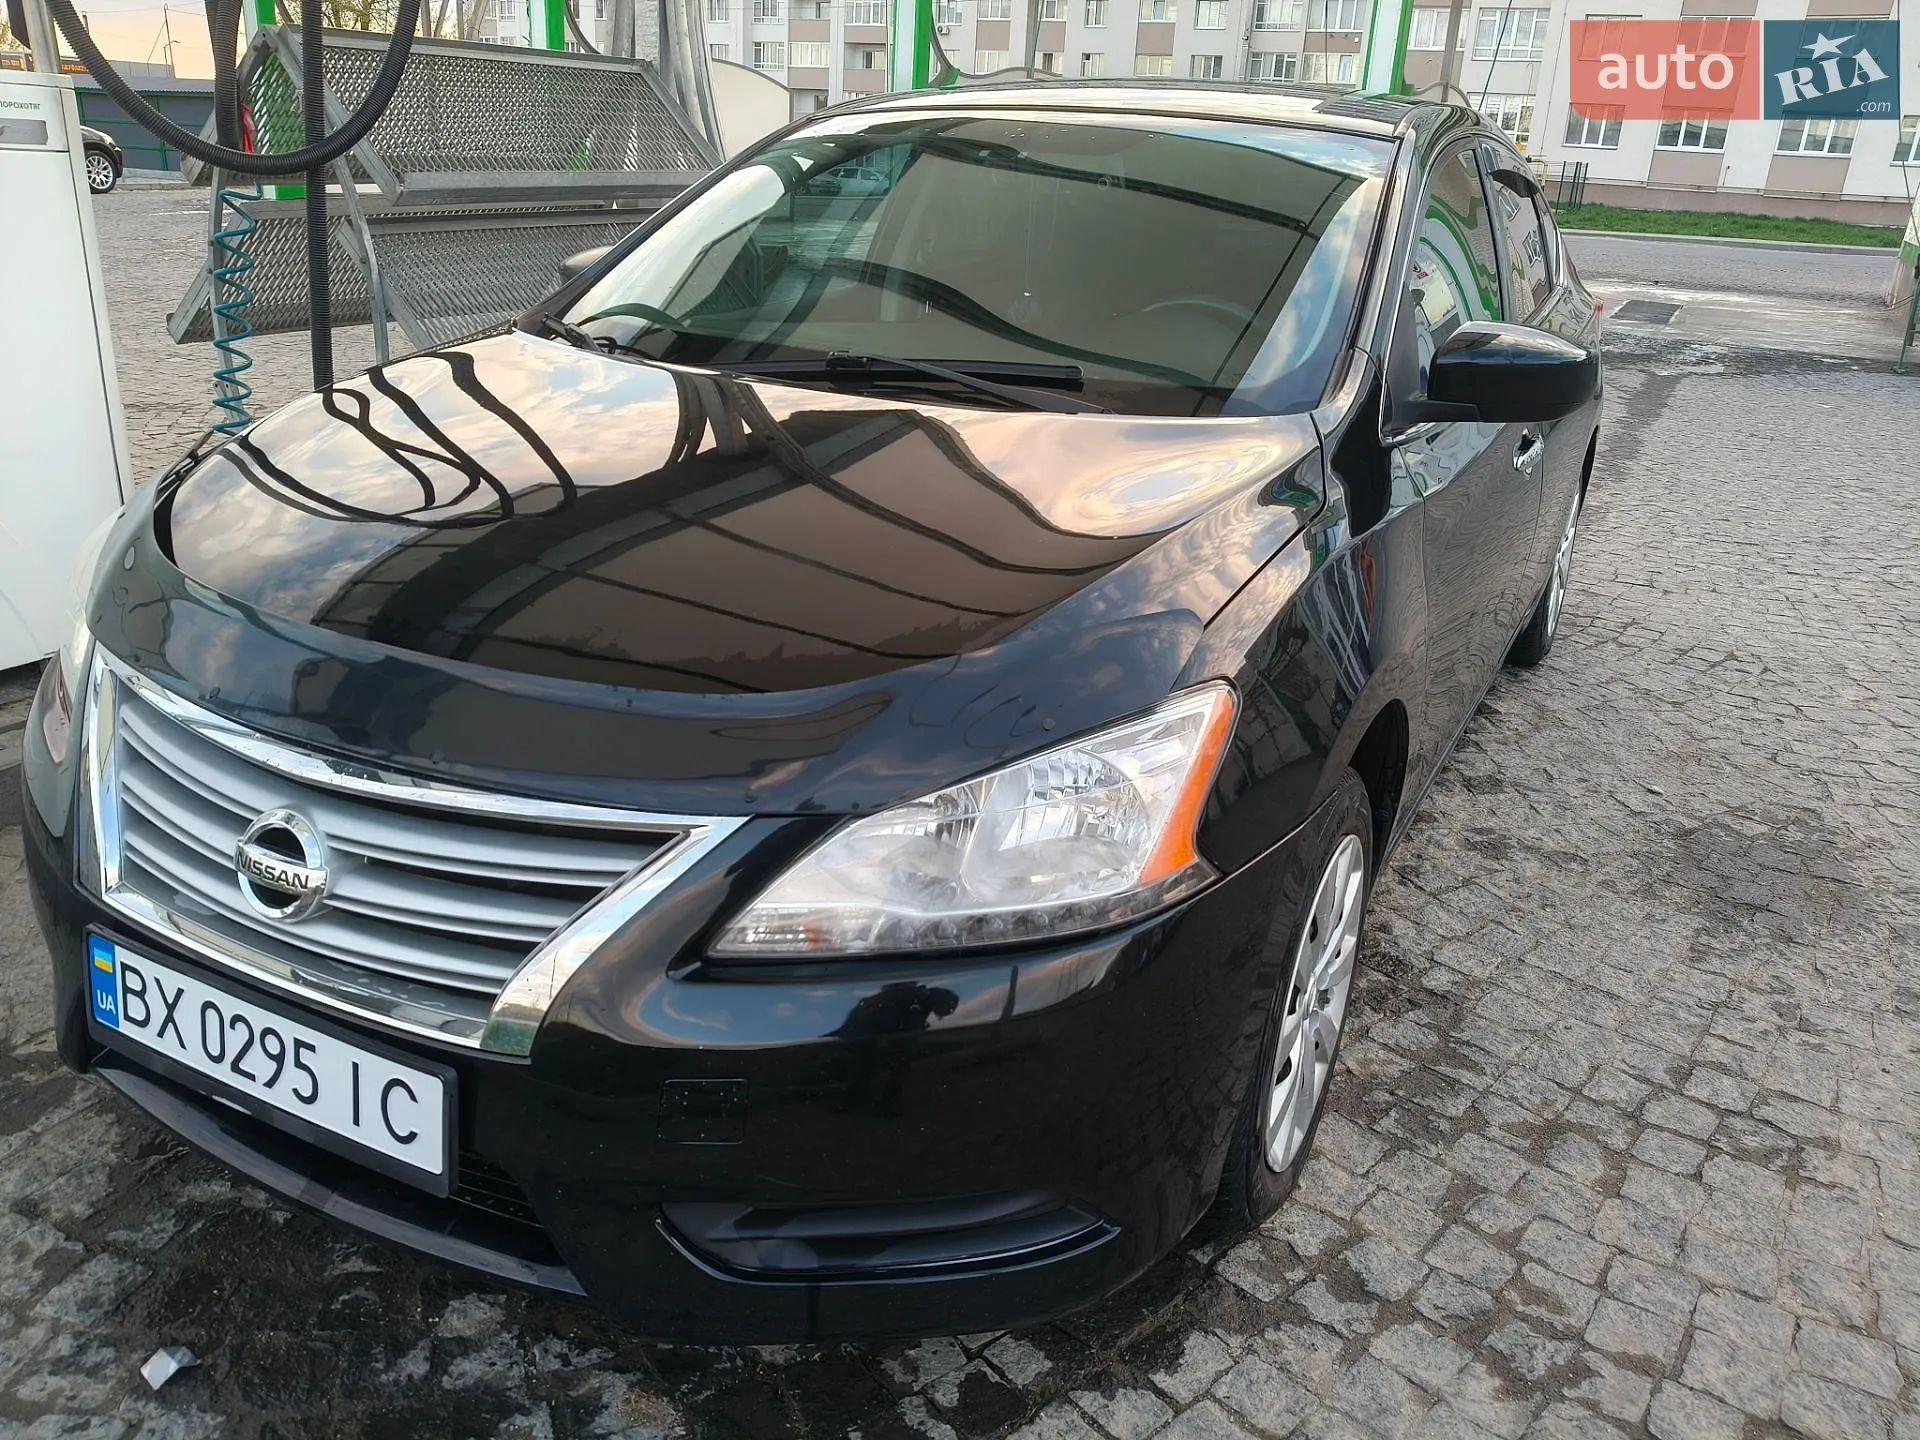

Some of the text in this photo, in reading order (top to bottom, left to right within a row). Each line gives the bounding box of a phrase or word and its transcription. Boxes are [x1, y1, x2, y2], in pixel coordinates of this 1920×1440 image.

[238, 852, 309, 889] NISSAN
[97, 989, 116, 1015] UA
[119, 960, 419, 1145] BX 0295 IC
